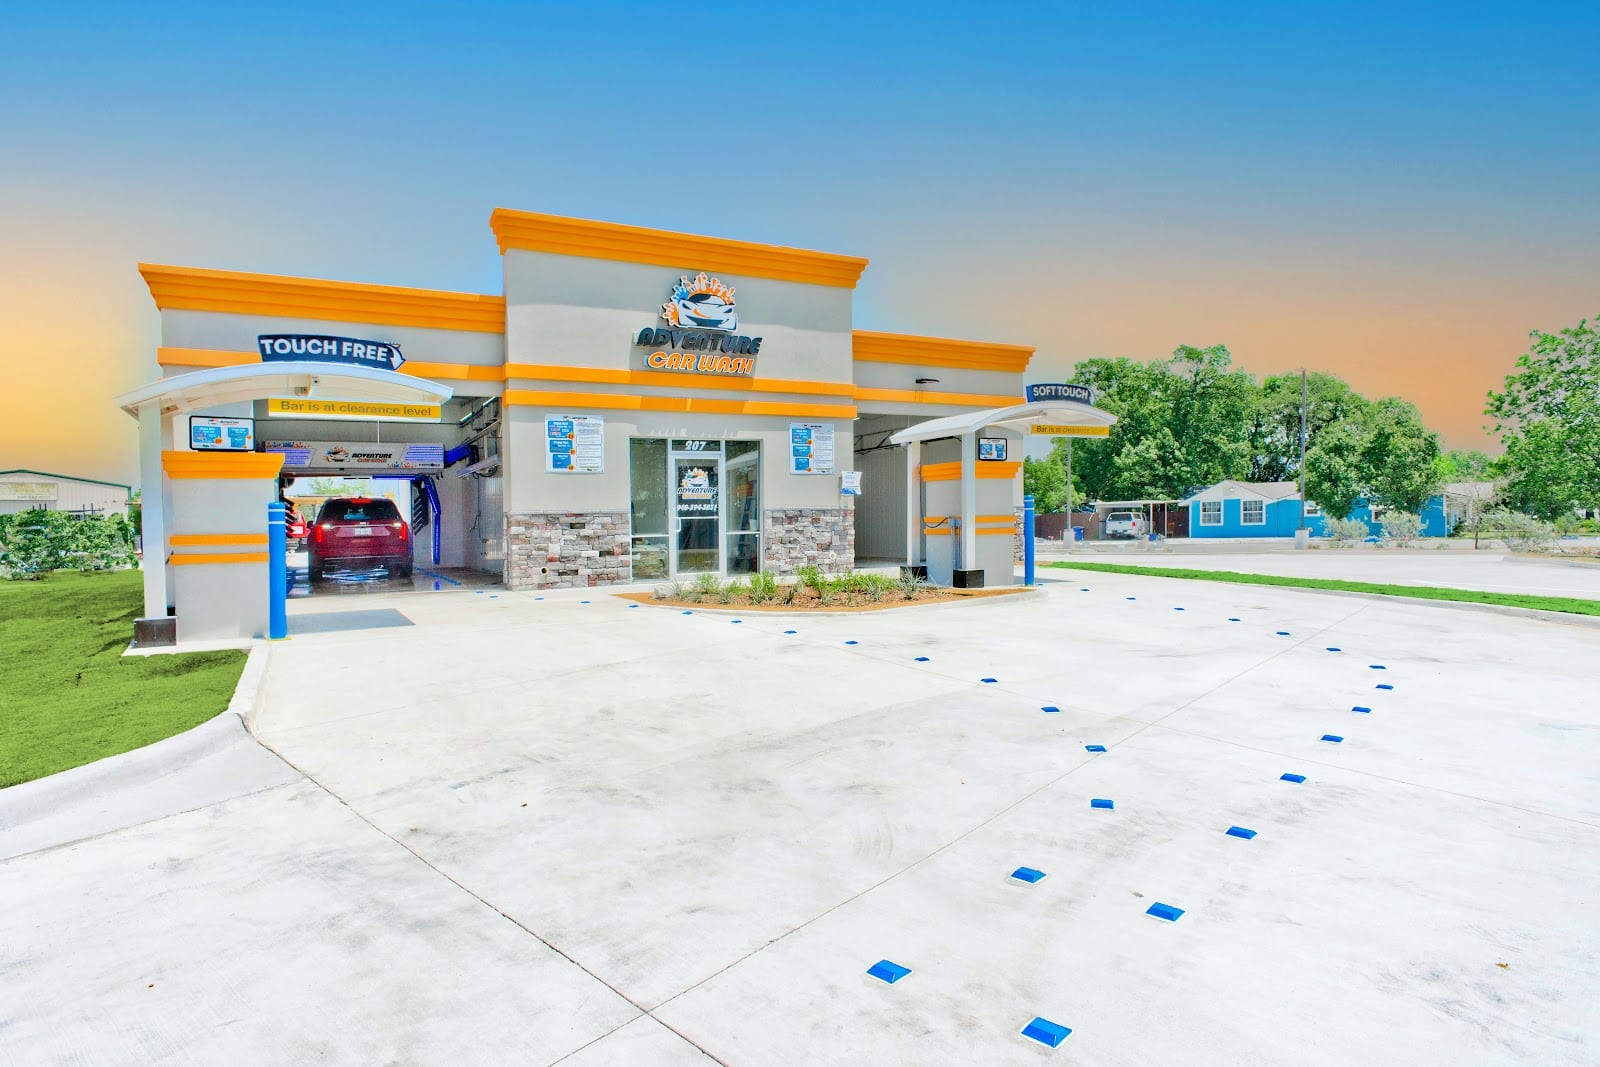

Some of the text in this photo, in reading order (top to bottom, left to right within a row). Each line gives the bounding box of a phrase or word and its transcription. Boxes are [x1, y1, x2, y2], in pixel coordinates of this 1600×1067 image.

[636, 327, 762, 355] ADVENTURE
[260, 338, 388, 362] TOUCH FREE
[648, 351, 754, 375] CAR WASH
[1033, 386, 1089, 400] SOFT TOUCH
[281, 400, 431, 417] Bar is at clearance level
[1036, 425, 1047, 433] Bar
[685, 440, 707, 451] 207
